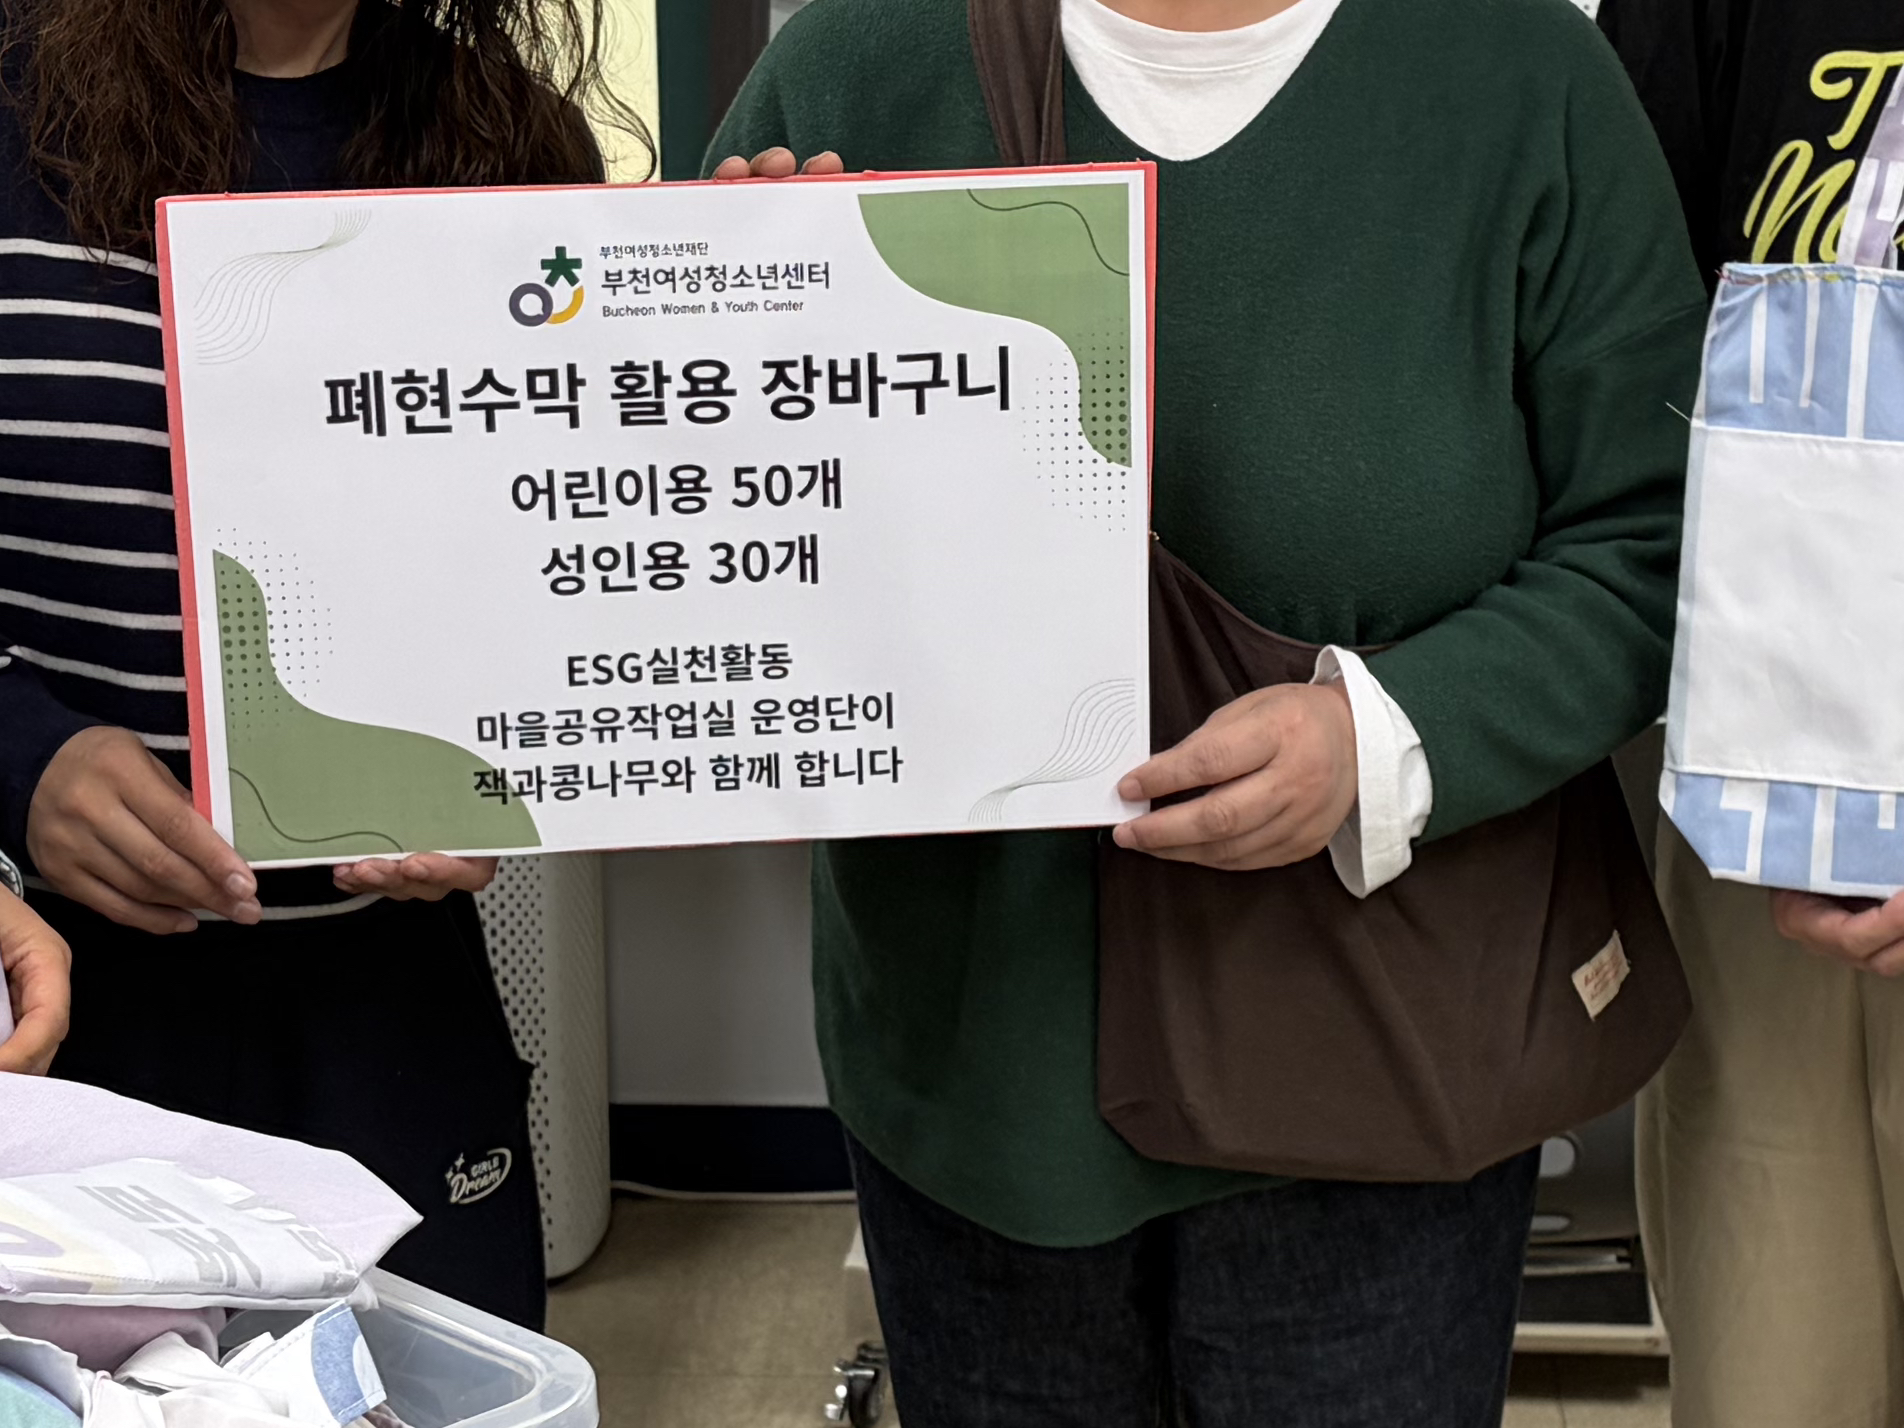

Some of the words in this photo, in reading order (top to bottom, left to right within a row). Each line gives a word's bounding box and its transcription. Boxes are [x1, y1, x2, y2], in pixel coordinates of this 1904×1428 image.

[599, 242, 709, 259] 부천여성청소년재단
[601, 262, 830, 296] 부천여성청소년센터
[602, 305, 656, 317] Bucheon
[661, 304, 705, 315] Women
[711, 301, 719, 313] &
[725, 301, 758, 313] Youth
[764, 300, 804, 312] Center
[324, 363, 586, 437] 폐현수막
[610, 359, 737, 427] 활용
[761, 345, 1010, 421] 장바구니
[511, 464, 712, 521] 어린이용
[731, 458, 842, 509] 50개
[541, 541, 690, 596] 성인용
[709, 533, 819, 585] 30개
[567, 643, 792, 687] ESG실천활동
[477, 699, 735, 750] 마을공유작업실
[750, 692, 893, 735] 운영단이
[473, 756, 696, 806] 잭과콩나무와
[709, 752, 780, 792] 함께
[794, 746, 903, 788] 합니다
